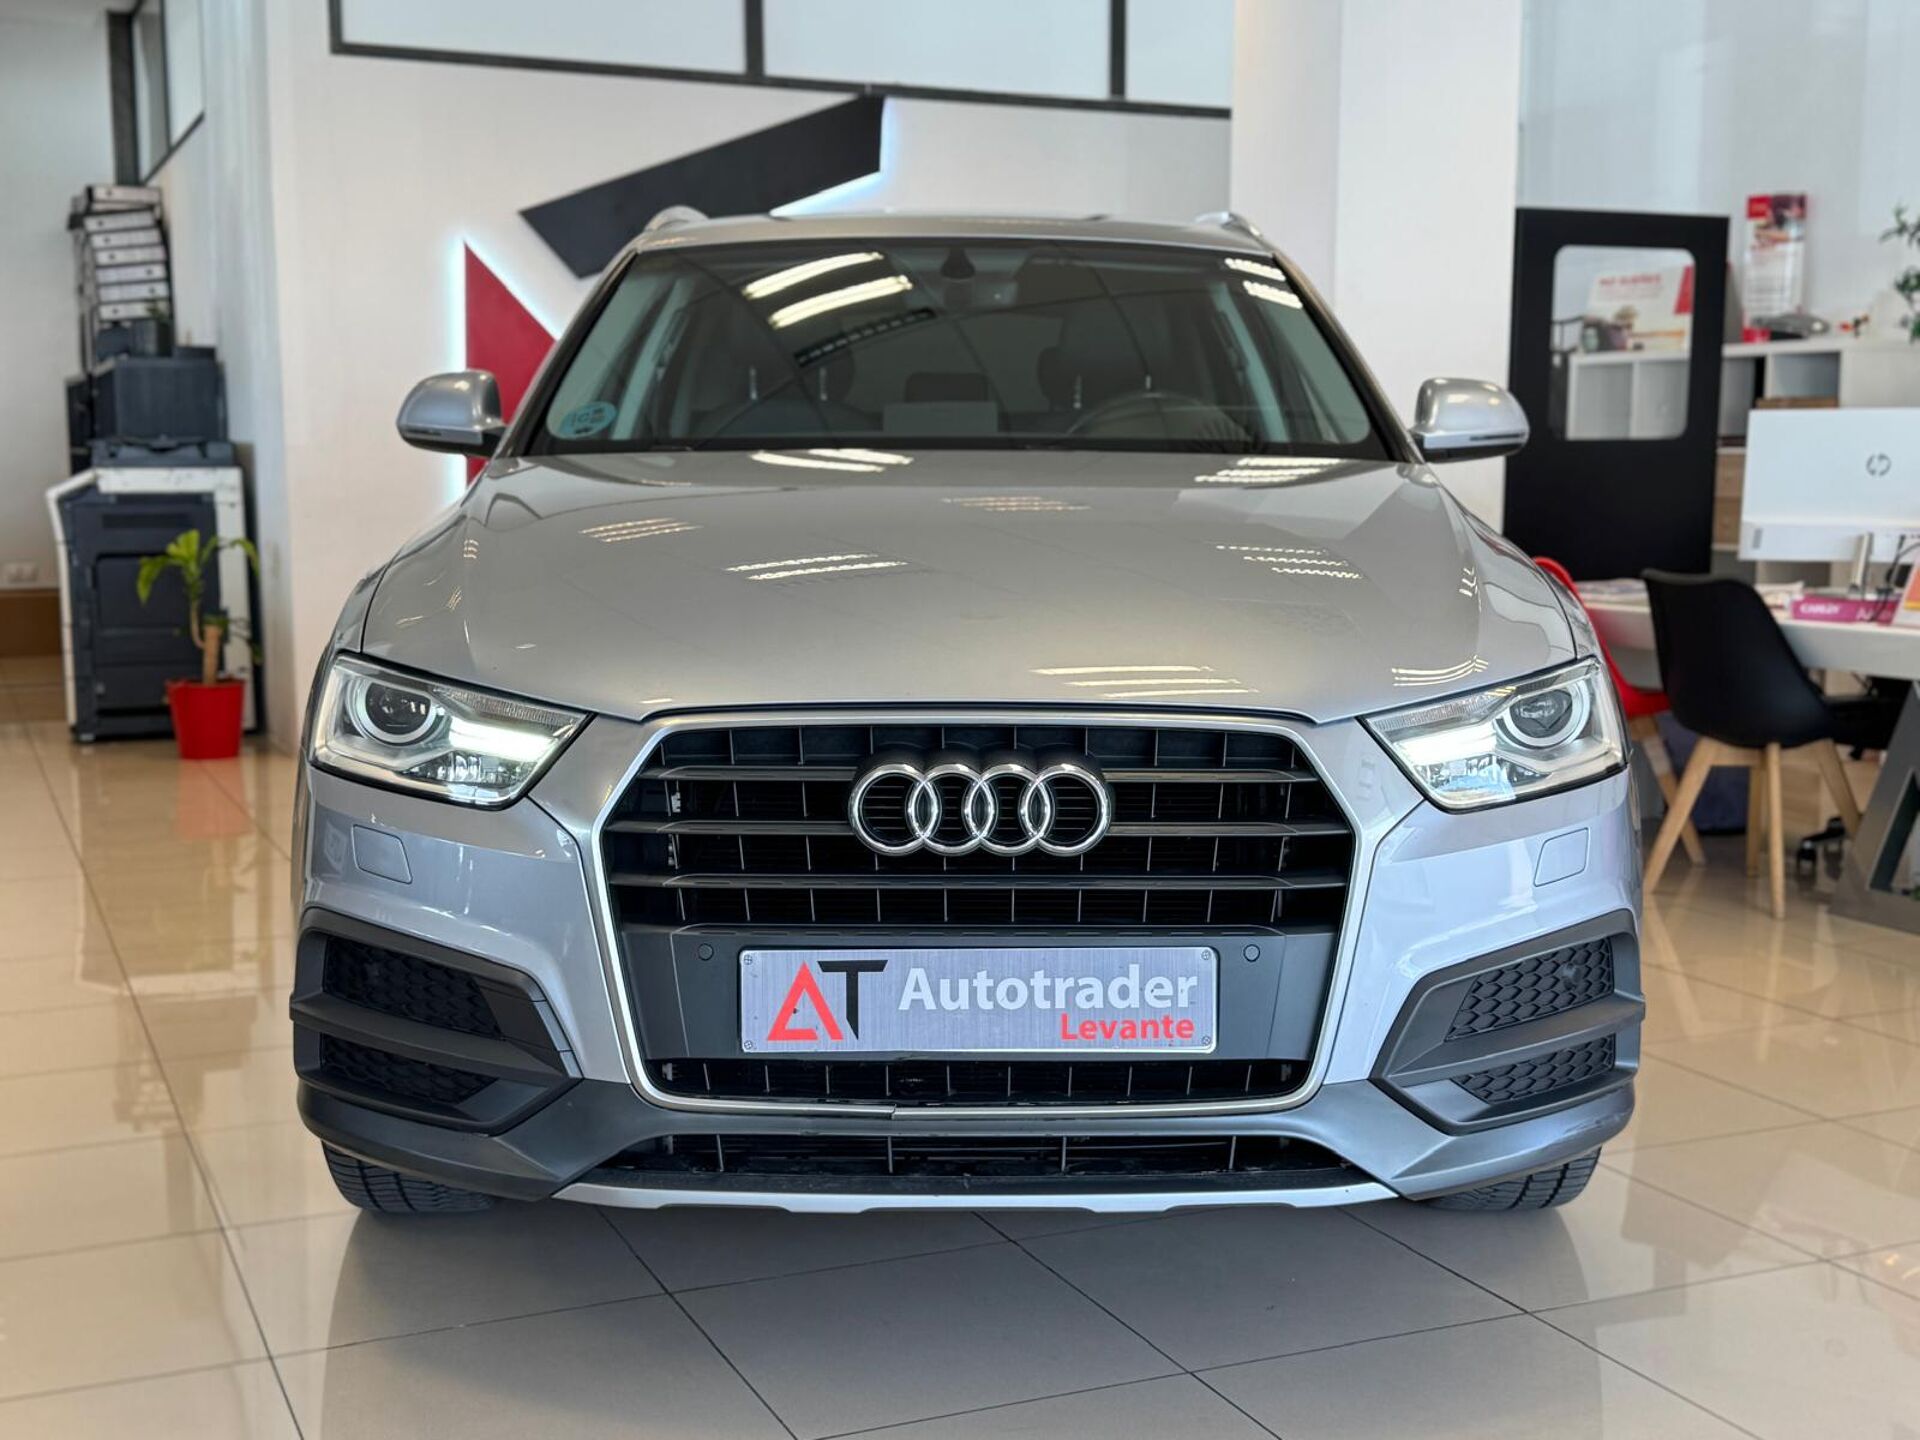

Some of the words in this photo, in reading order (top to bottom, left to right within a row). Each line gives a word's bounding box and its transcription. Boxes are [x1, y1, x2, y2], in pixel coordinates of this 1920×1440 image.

[767, 959, 889, 1041] AT
[898, 963, 1198, 1010] Autotrader
[1061, 1012, 1195, 1041] Levante
